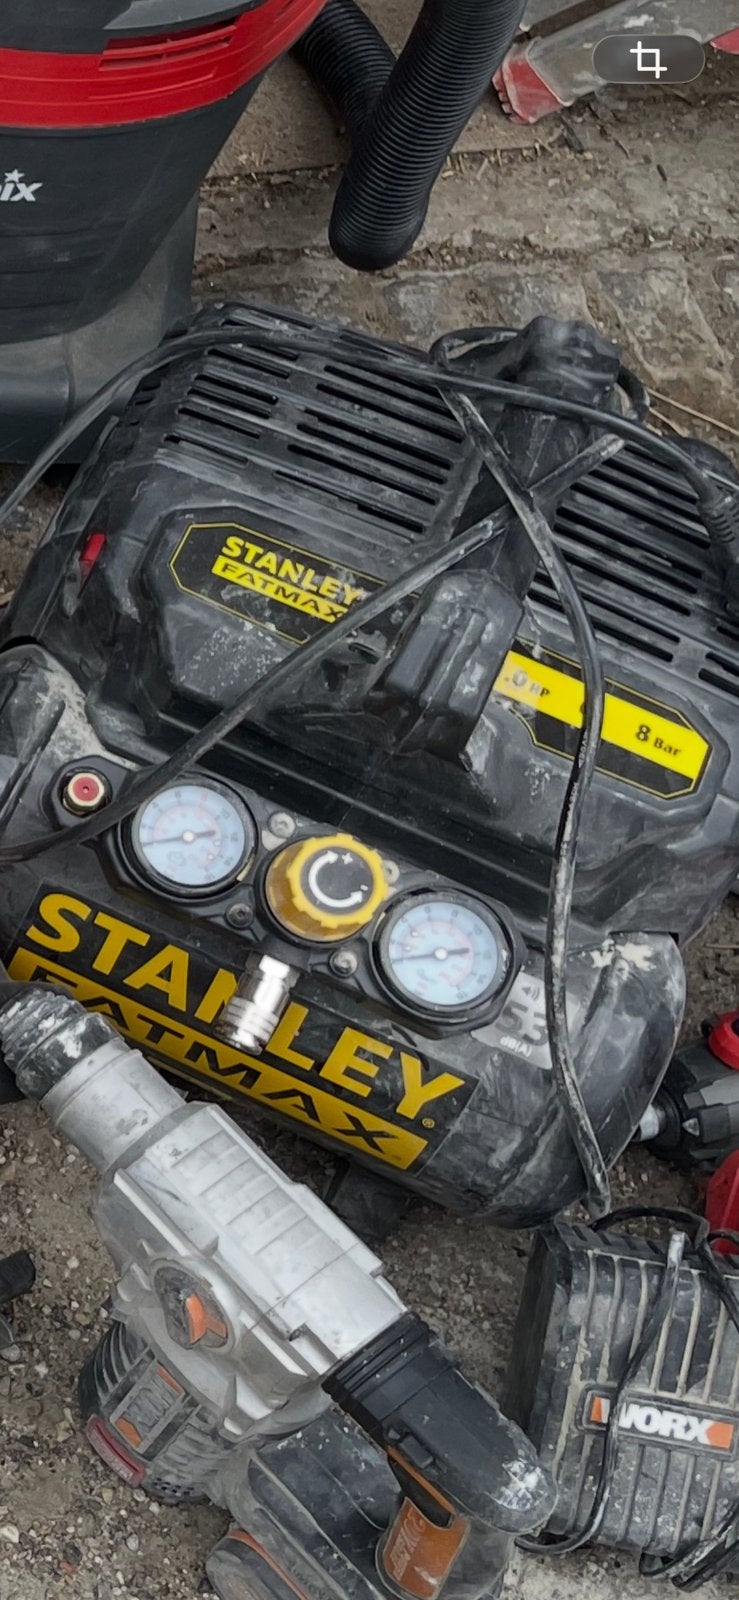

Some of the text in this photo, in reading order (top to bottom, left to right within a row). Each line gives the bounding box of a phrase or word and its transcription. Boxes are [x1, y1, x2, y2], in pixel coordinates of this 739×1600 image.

[0, 168, 43, 202] ix
[222, 535, 364, 606] STANLEY
[220, 561, 345, 619] FATMAX
[635, 724, 652, 742] 8
[653, 736, 682, 756] Bar
[500, 1036, 532, 1057] dB(A)
